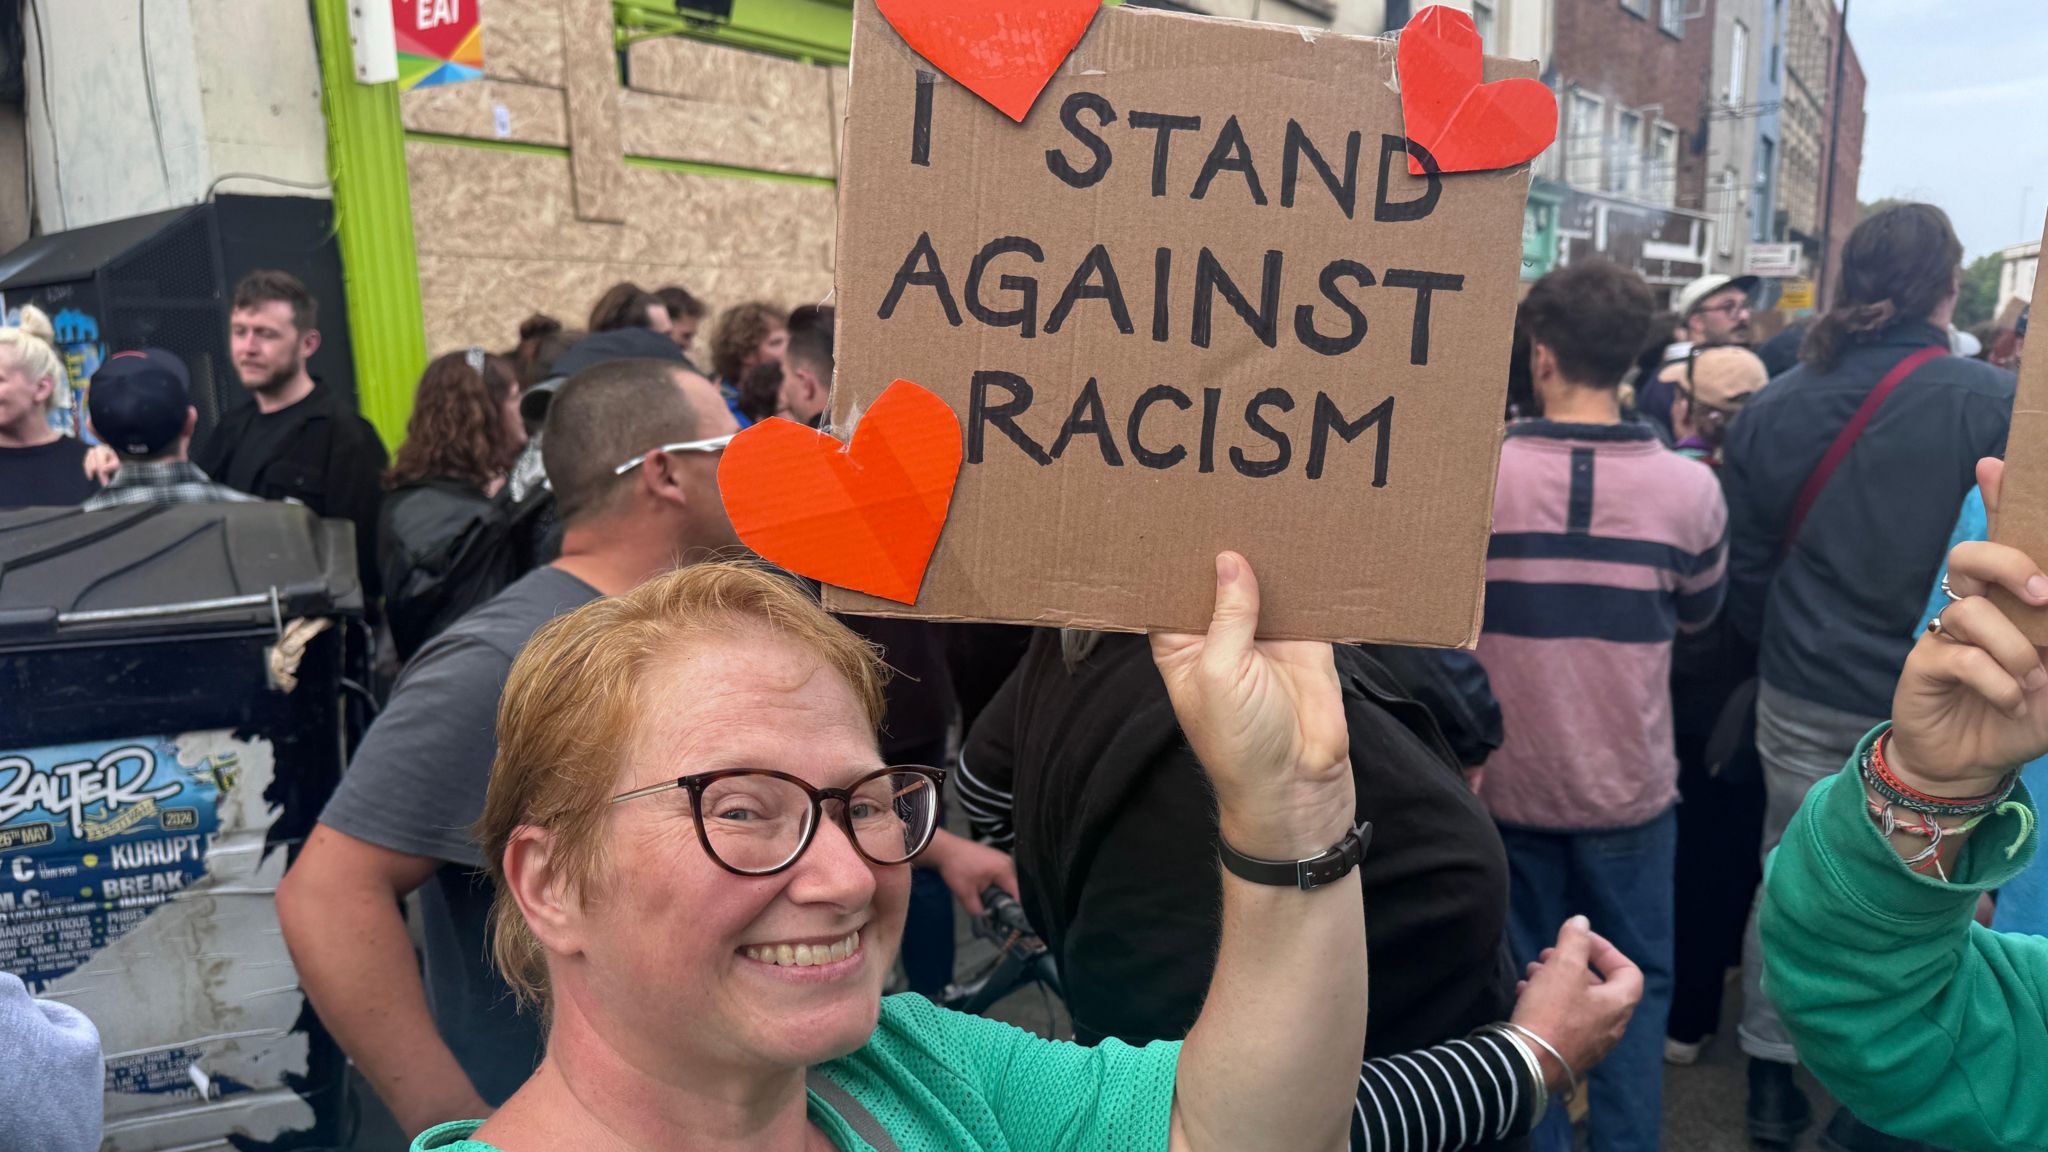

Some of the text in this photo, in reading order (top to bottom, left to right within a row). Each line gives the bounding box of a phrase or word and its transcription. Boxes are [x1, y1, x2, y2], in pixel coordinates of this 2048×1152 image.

[911, 70, 1443, 223] I STAND
[877, 231, 1465, 366] AGAINST
[967, 370, 1396, 489] RACISM
[0, 747, 182, 838] BALTER
[165, 810, 193, 828] 2024
[21, 826, 48, 845] MAY
[111, 834, 200, 870] KURUPT
[103, 869, 184, 899] BREAK
